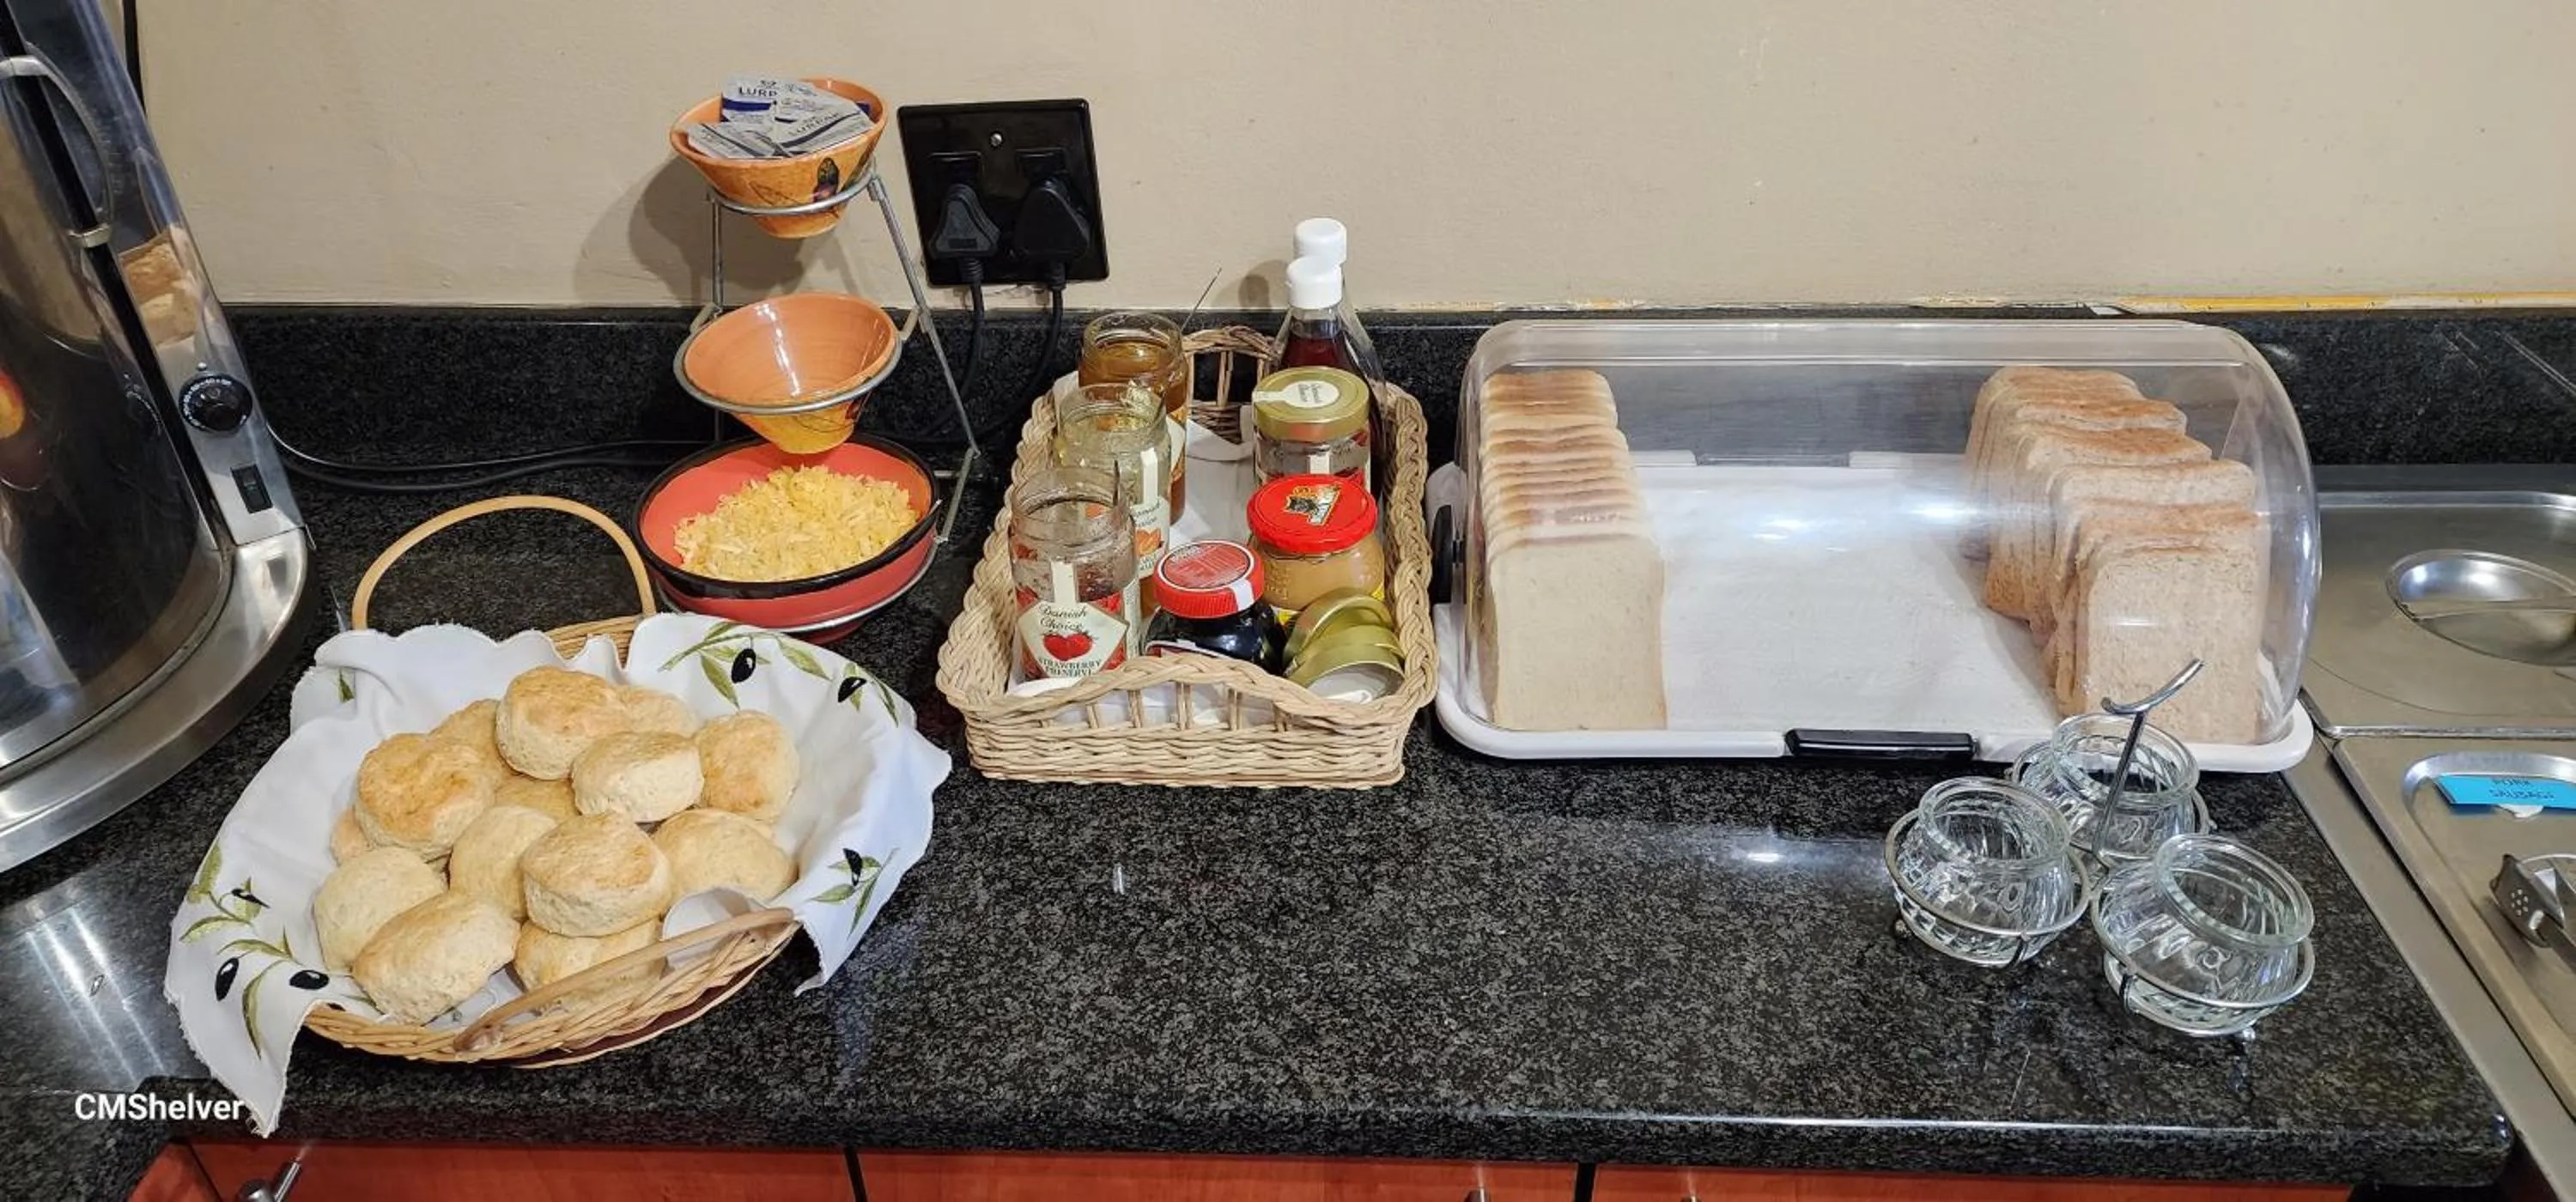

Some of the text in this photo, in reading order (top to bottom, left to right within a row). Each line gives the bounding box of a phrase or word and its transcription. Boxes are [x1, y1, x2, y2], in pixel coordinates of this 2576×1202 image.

[738, 87, 777, 97] LURP
[1039, 604, 1087, 617] Danish
[1040, 617, 1084, 630] Choice
[1038, 658, 1103, 670] STRAWBERRY
